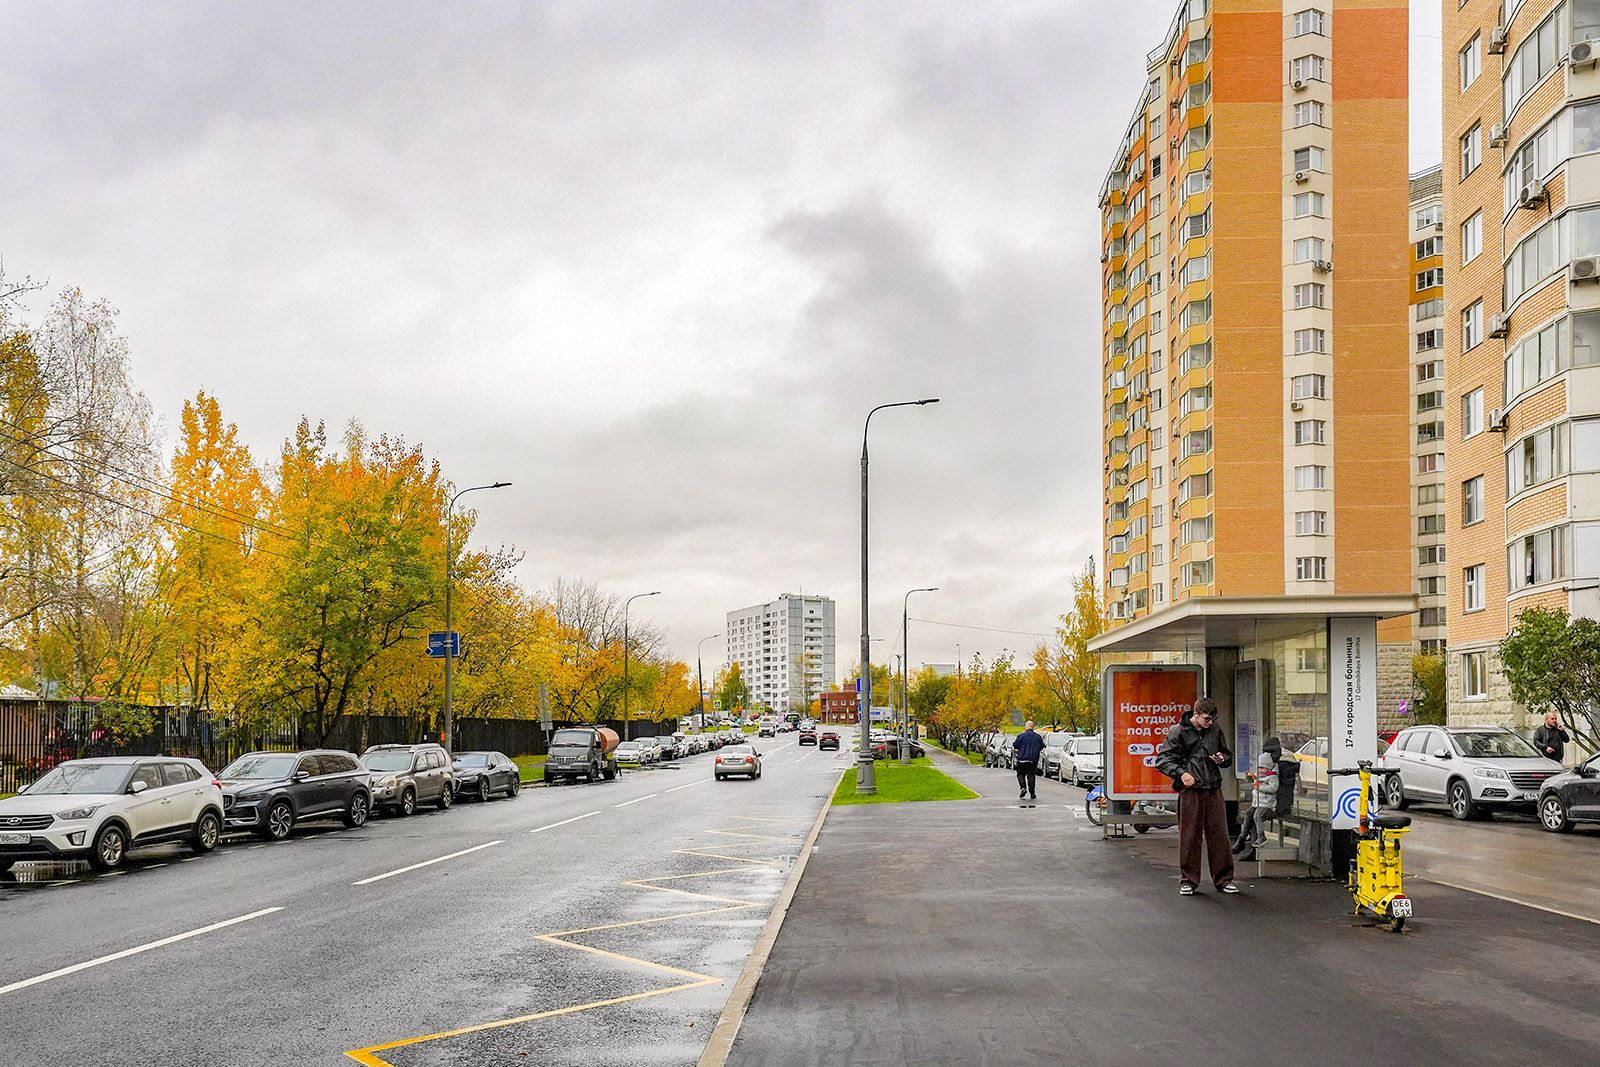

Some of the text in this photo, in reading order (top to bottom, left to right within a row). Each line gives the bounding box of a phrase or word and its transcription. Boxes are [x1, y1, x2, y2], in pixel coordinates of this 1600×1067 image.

[1345, 637, 1354, 748] 17-я городская больница
[1355, 694, 1361, 702] 17
[1120, 702, 1191, 715] Настройте
[1135, 715, 1177, 725] отдых
[1127, 727, 1170, 737] под се
